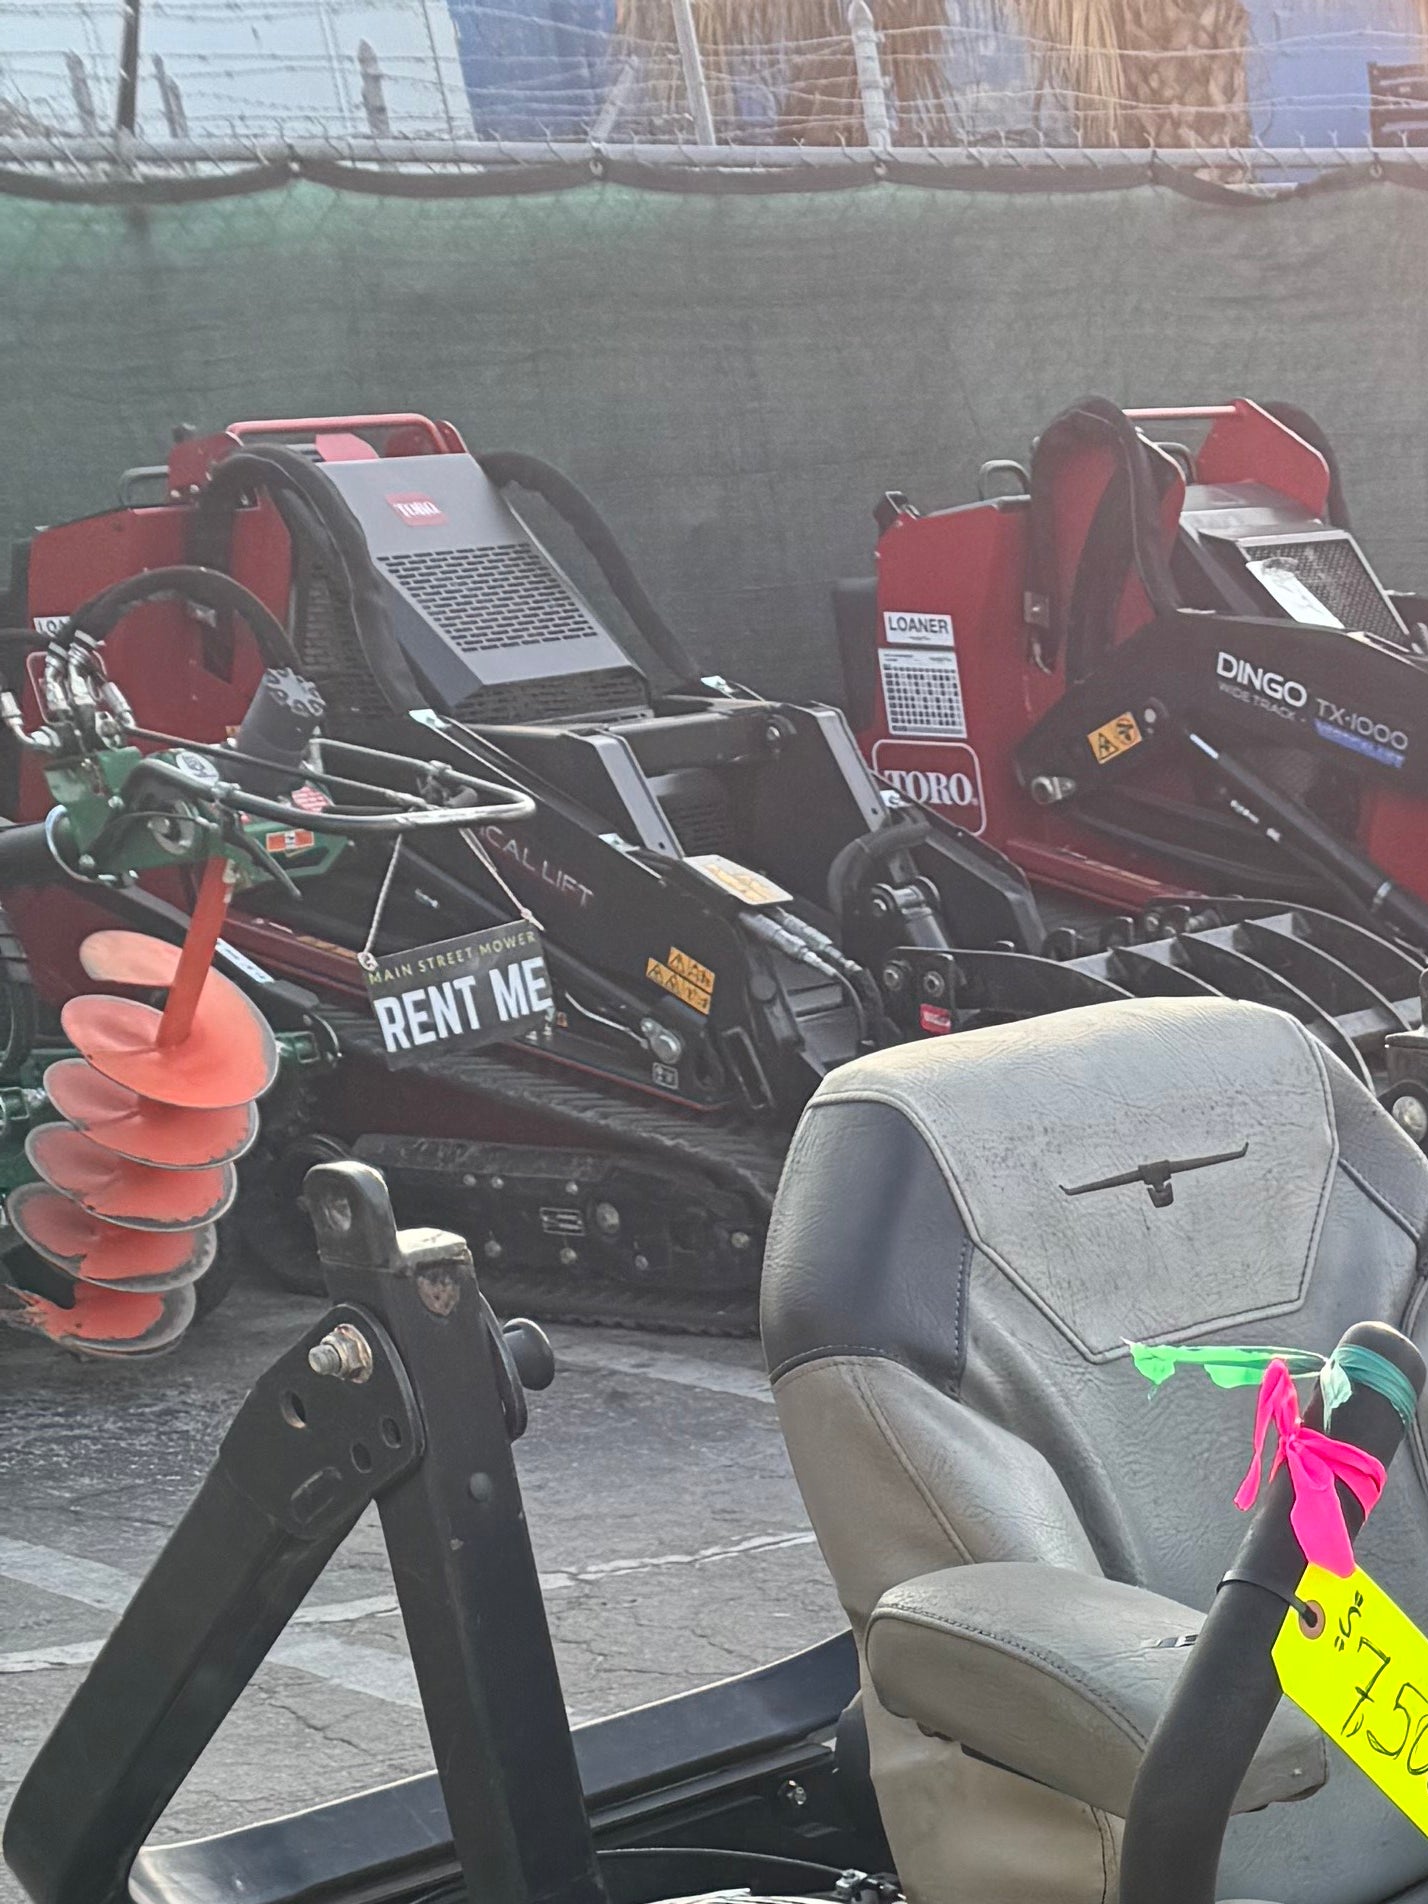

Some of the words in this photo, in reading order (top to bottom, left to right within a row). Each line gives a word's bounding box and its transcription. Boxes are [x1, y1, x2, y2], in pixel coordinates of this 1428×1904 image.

[887, 615, 950, 635] LOANER
[1216, 651, 1308, 707] DINGO
[883, 769, 975, 807] TORO
[541, 860, 594, 907] LIFT
[367, 964, 413, 985] MAIN
[417, 947, 474, 973] STREET
[478, 930, 538, 957] MOWER
[373, 975, 481, 1053] RENT
[488, 956, 554, 1022] ME
